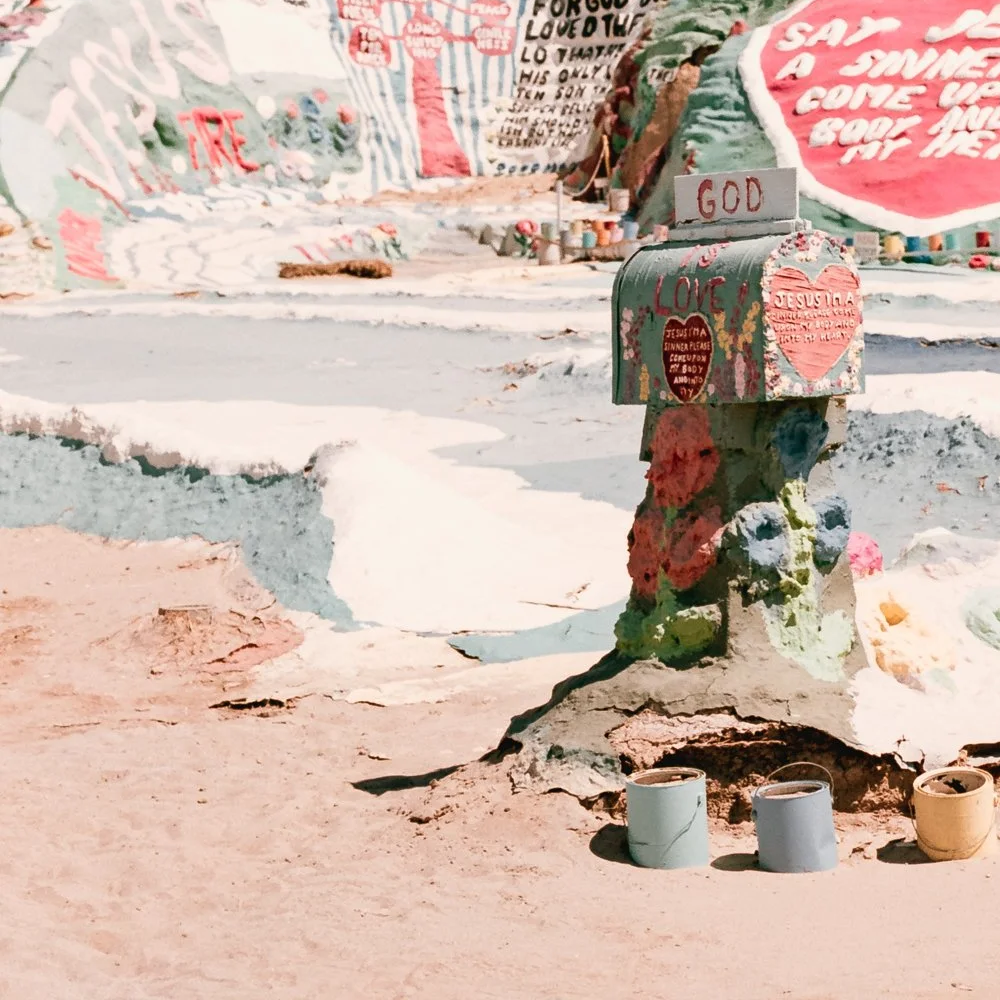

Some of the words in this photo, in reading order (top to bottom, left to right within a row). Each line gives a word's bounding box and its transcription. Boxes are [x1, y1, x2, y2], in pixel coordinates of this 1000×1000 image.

[776, 17, 901, 50] SAY
[520, 70, 550, 85] HIS
[775, 52, 816, 80] A
[793, 83, 927, 116] COME
[808, 115, 922, 148] BODY
[838, 138, 912, 166] MY
[697, 176, 763, 219] GOD
[774, 291, 821, 309] JESUS
[846, 291, 854, 306] A
[664, 342, 689, 352] SINNER
[689, 341, 711, 351] PLEASE
[665, 329, 688, 339] JESUS
[700, 327, 707, 337] A
[682, 364, 703, 374] BODY
